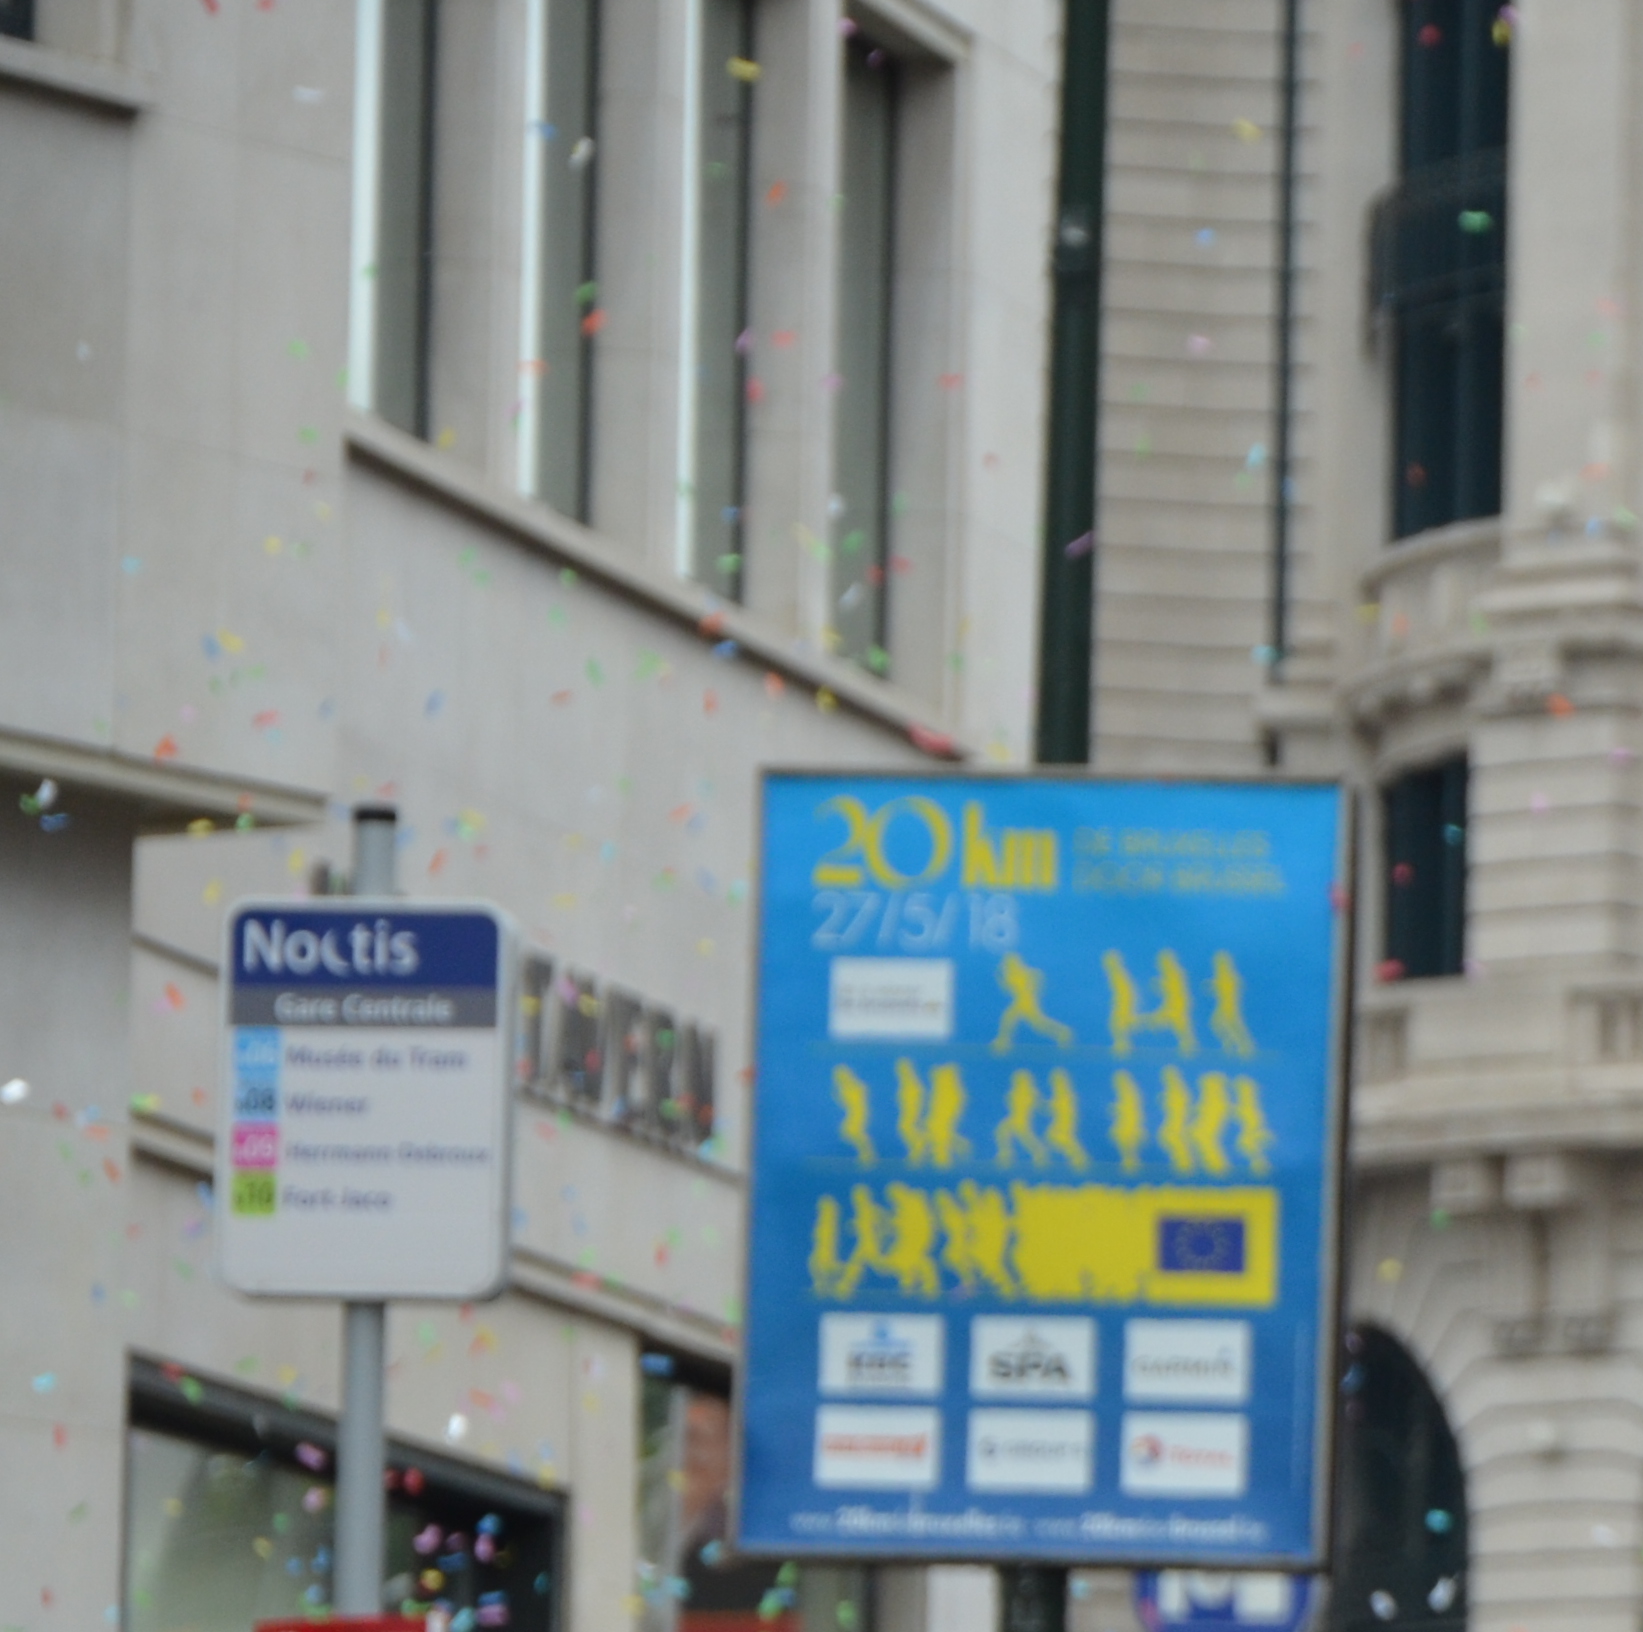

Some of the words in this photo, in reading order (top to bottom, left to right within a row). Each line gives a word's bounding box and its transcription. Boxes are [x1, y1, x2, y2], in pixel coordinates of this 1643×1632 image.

[242, 918, 420, 976] Noctis
[274, 993, 337, 1024] Gare
[342, 993, 456, 1024] Centrale
[988, 1353, 1071, 1384] SPA
